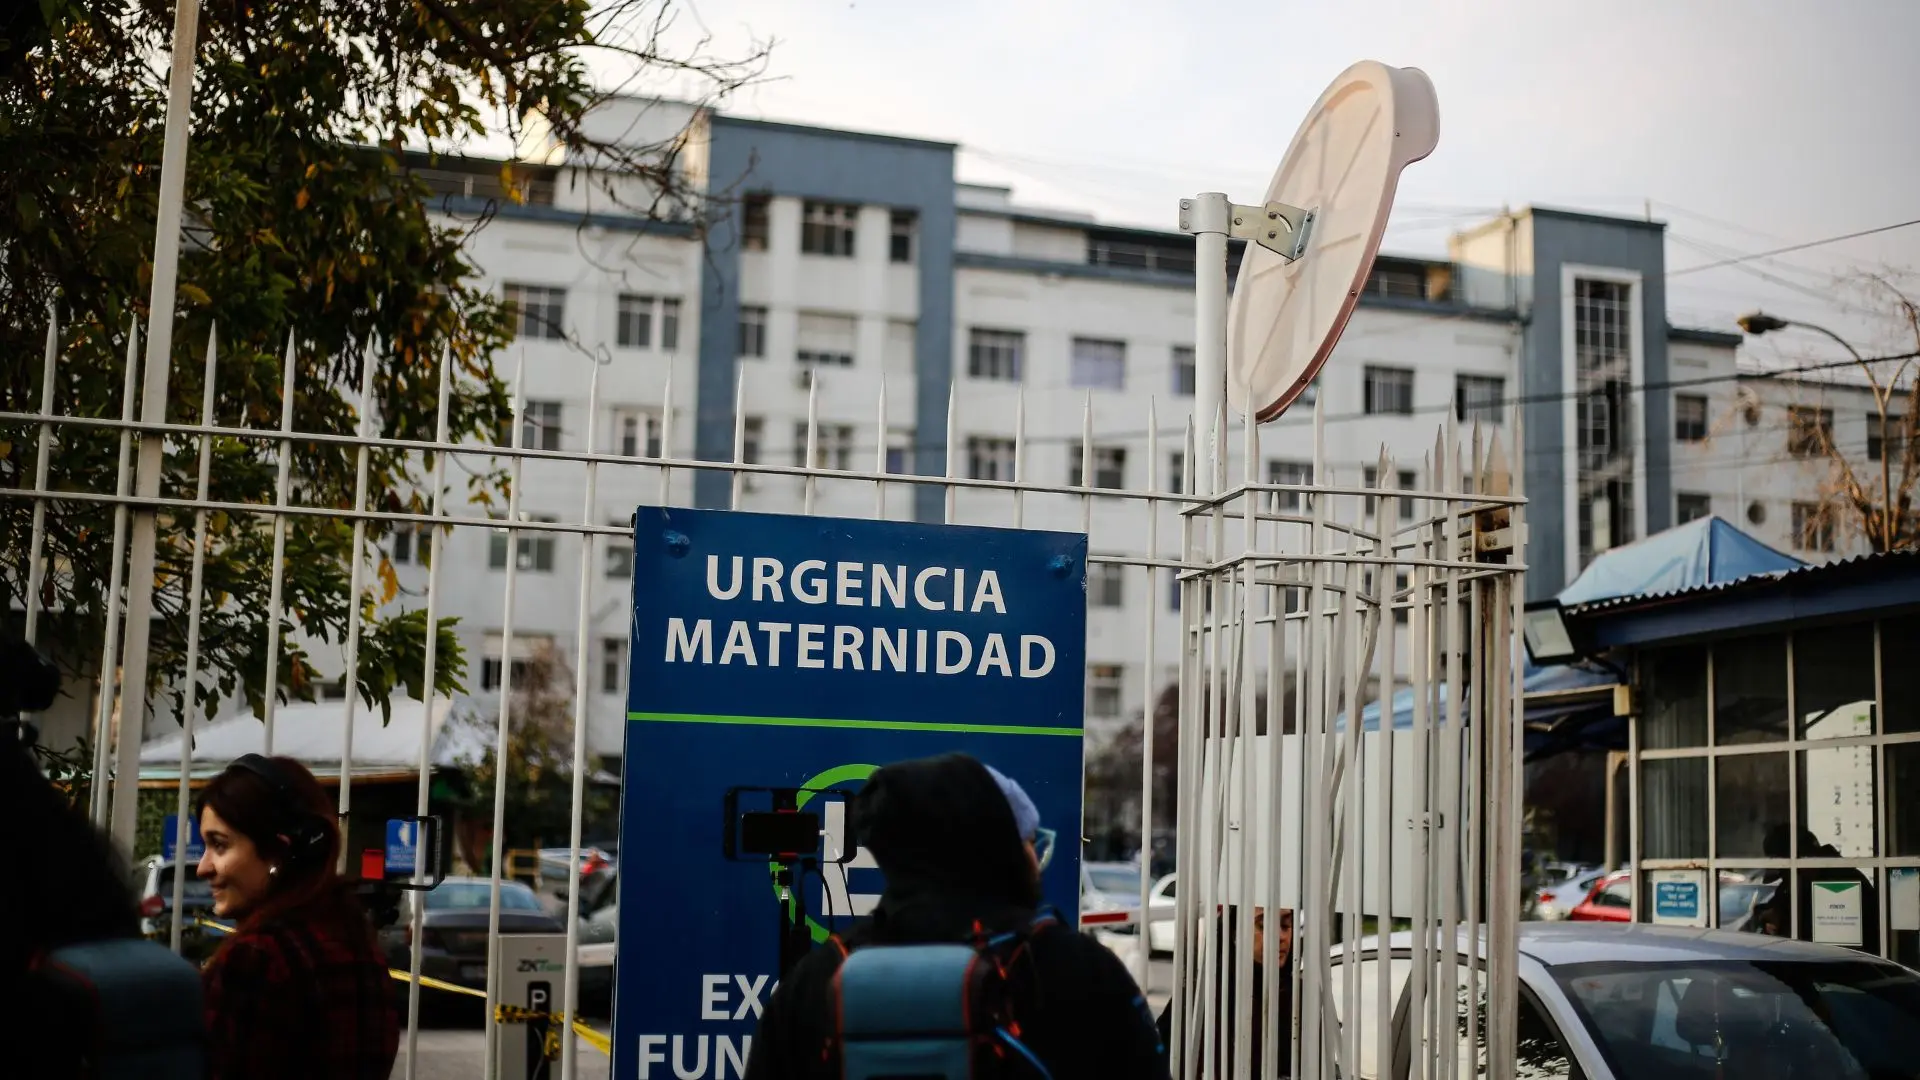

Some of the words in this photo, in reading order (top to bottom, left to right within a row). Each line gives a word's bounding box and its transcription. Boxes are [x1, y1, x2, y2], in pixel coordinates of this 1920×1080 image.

[706, 555, 1007, 614] URGENCIA
[664, 617, 1057, 678] MATERNIDAD
[530, 989, 548, 1012] P
[701, 974, 780, 1020] EX
